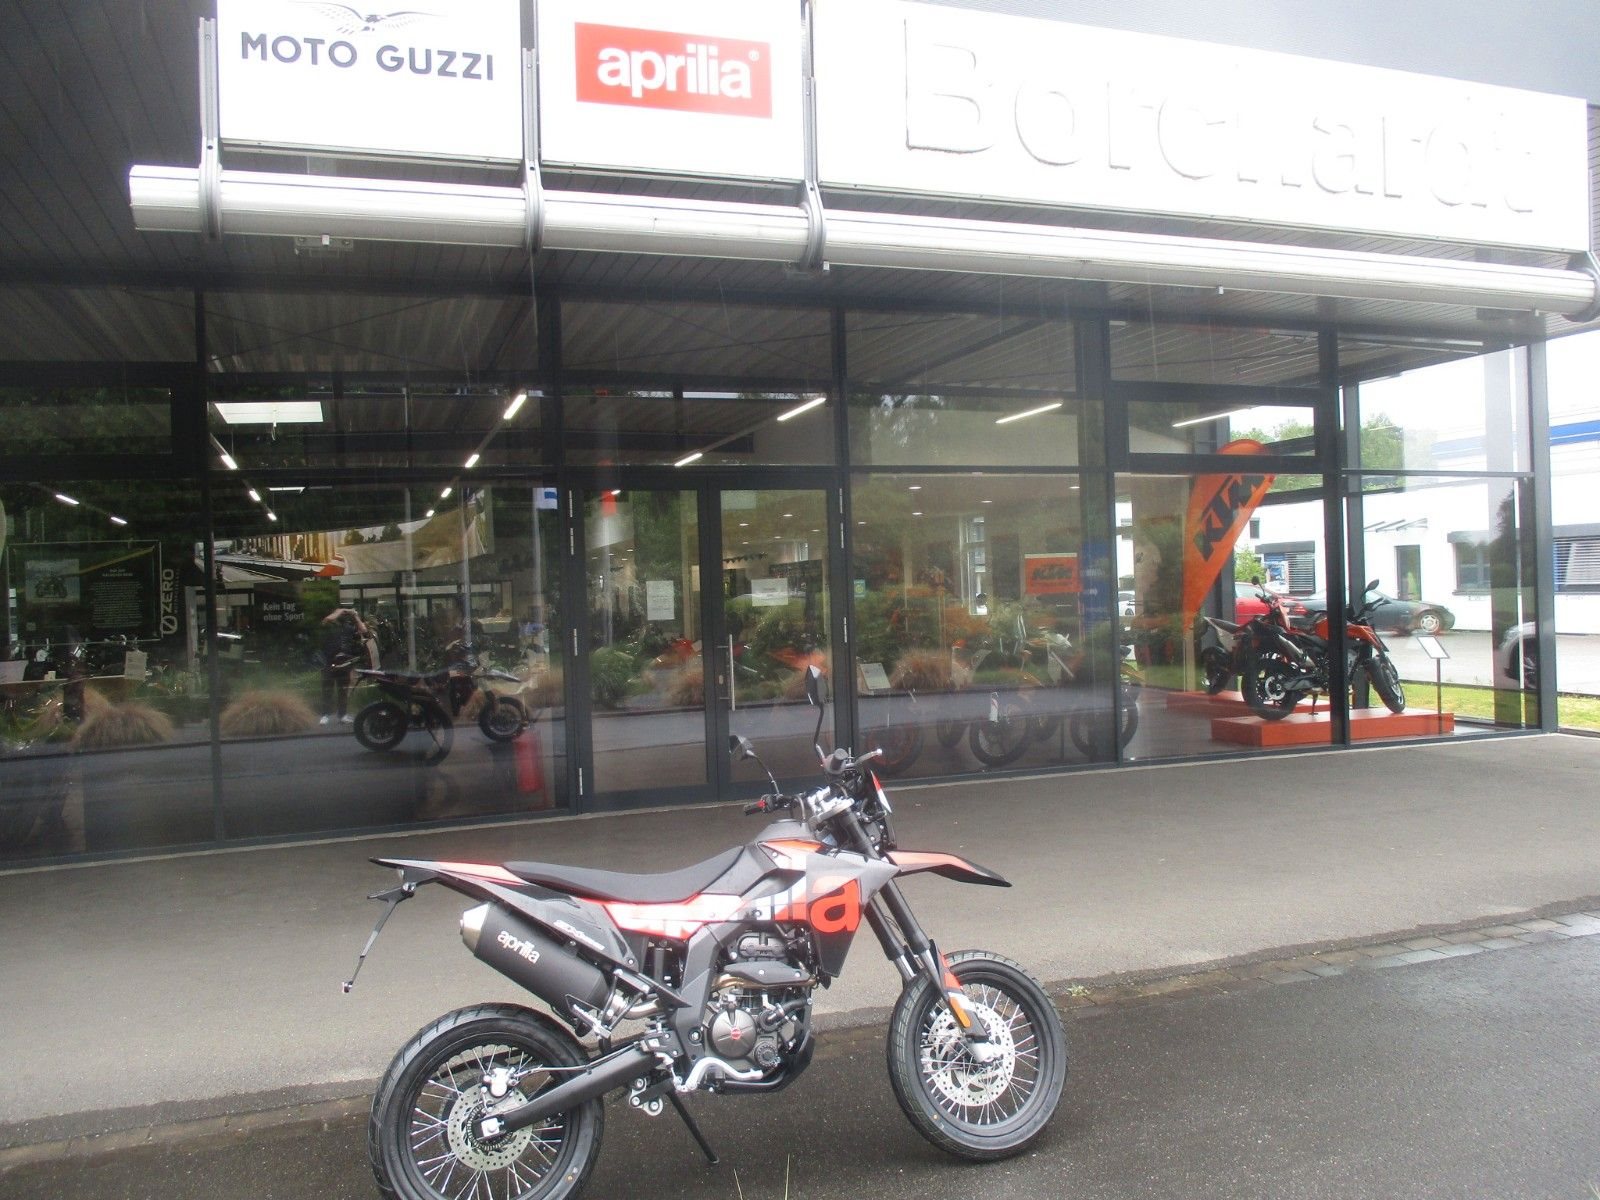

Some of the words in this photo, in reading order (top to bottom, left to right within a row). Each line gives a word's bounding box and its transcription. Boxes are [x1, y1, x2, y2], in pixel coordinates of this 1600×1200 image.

[241, 32, 358, 68] MOTO
[376, 44, 493, 80] GUZZI
[597, 43, 752, 98] aprilia
[1193, 474, 1265, 562] KTM
[162, 568, 175, 615] ZERO
[497, 930, 540, 964] aprilia
